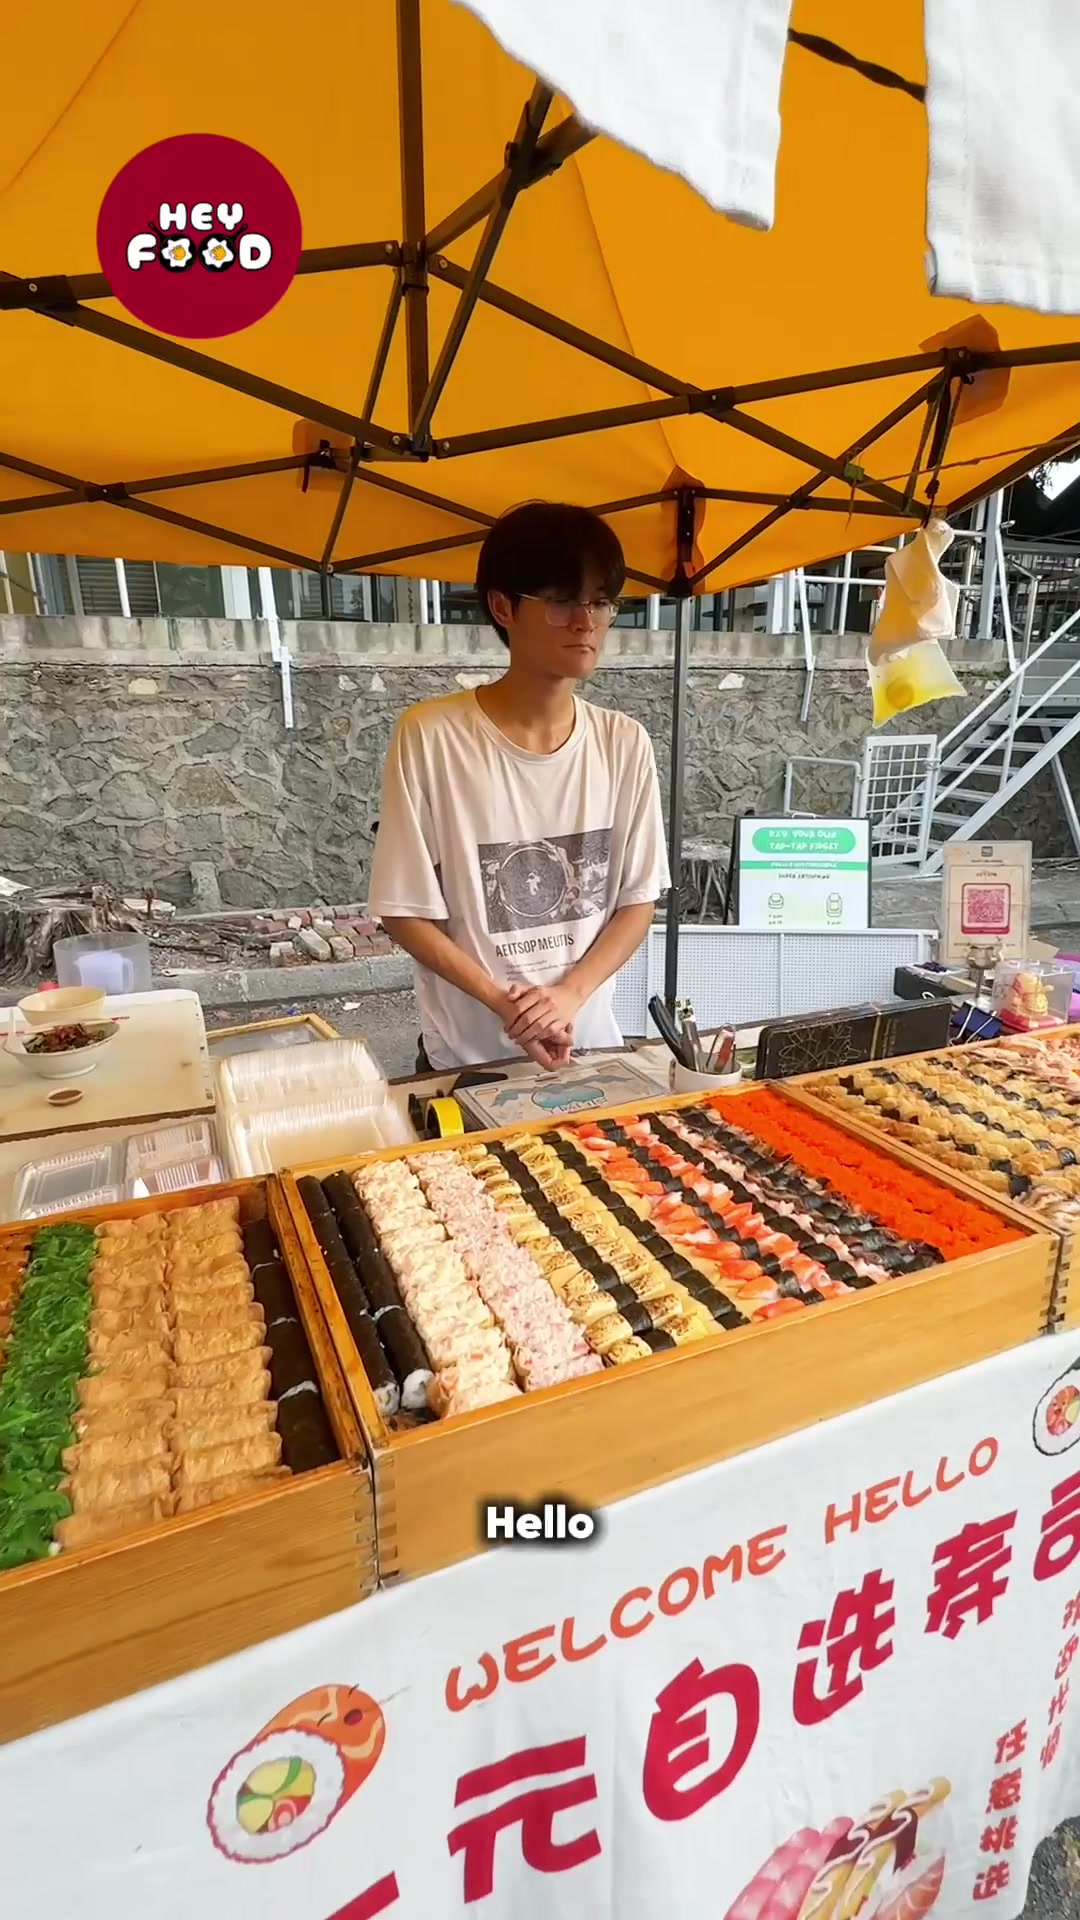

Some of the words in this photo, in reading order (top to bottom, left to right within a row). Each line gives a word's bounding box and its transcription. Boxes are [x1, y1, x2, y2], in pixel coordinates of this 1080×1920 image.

[443, 1523, 789, 1714] WELCOME
[823, 1435, 1000, 1546] HELLO
[972, 1717, 1029, 1901] 任意挑选
